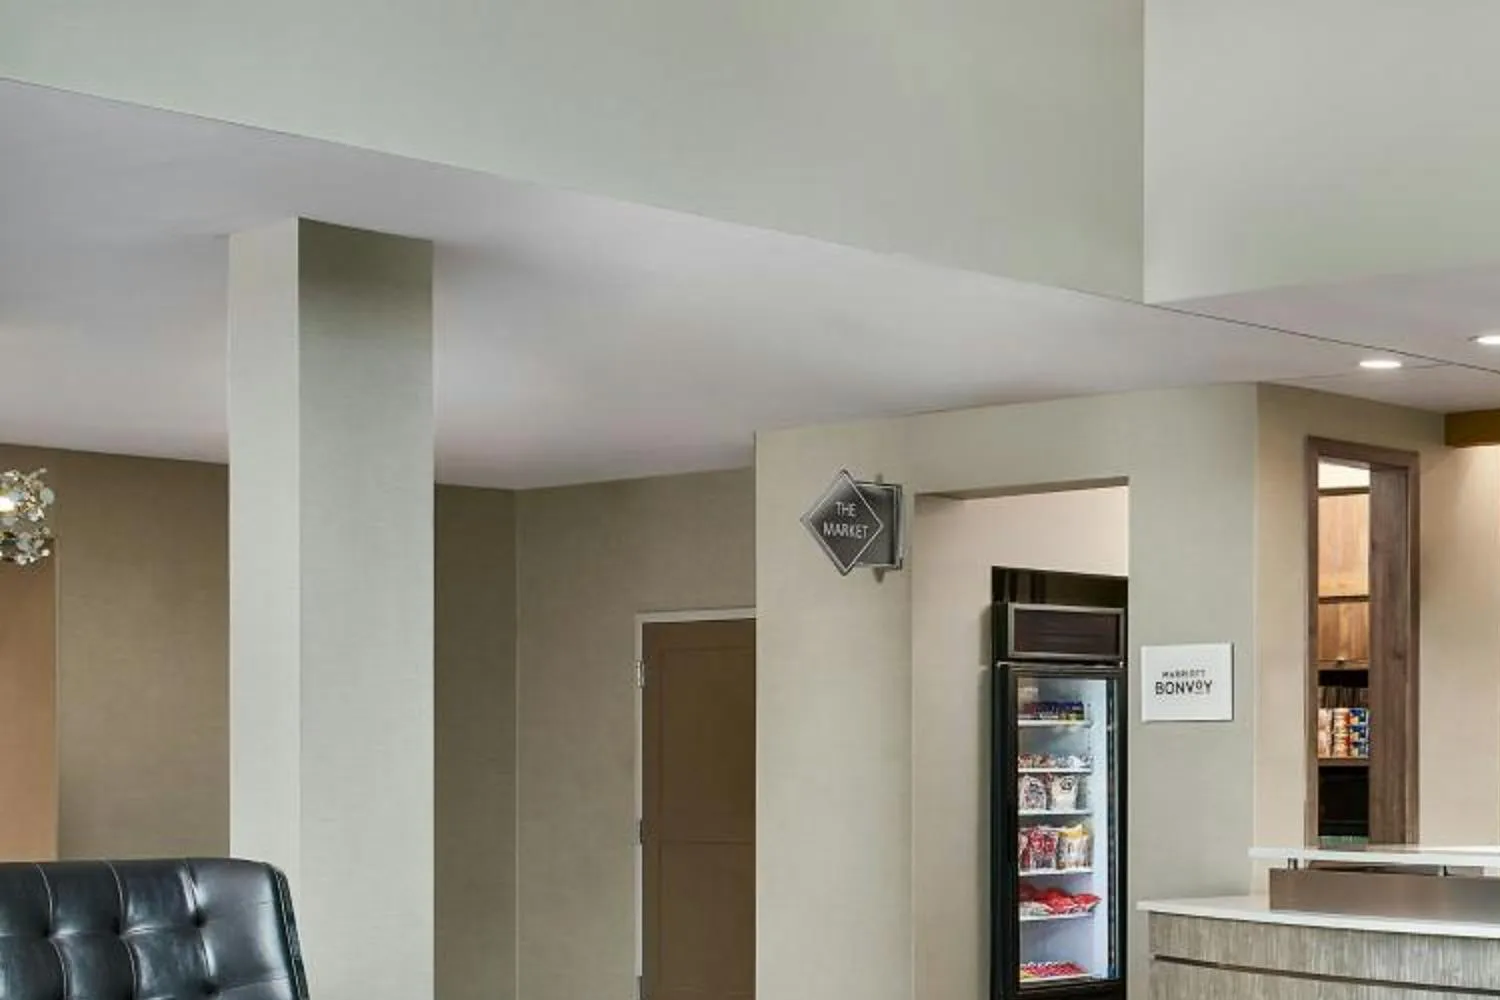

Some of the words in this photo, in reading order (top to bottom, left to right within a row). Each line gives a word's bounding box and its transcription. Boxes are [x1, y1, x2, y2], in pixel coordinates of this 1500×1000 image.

[835, 501, 857, 517] THE
[822, 521, 869, 539] MARKET
[1155, 680, 1213, 695] BONVOY
